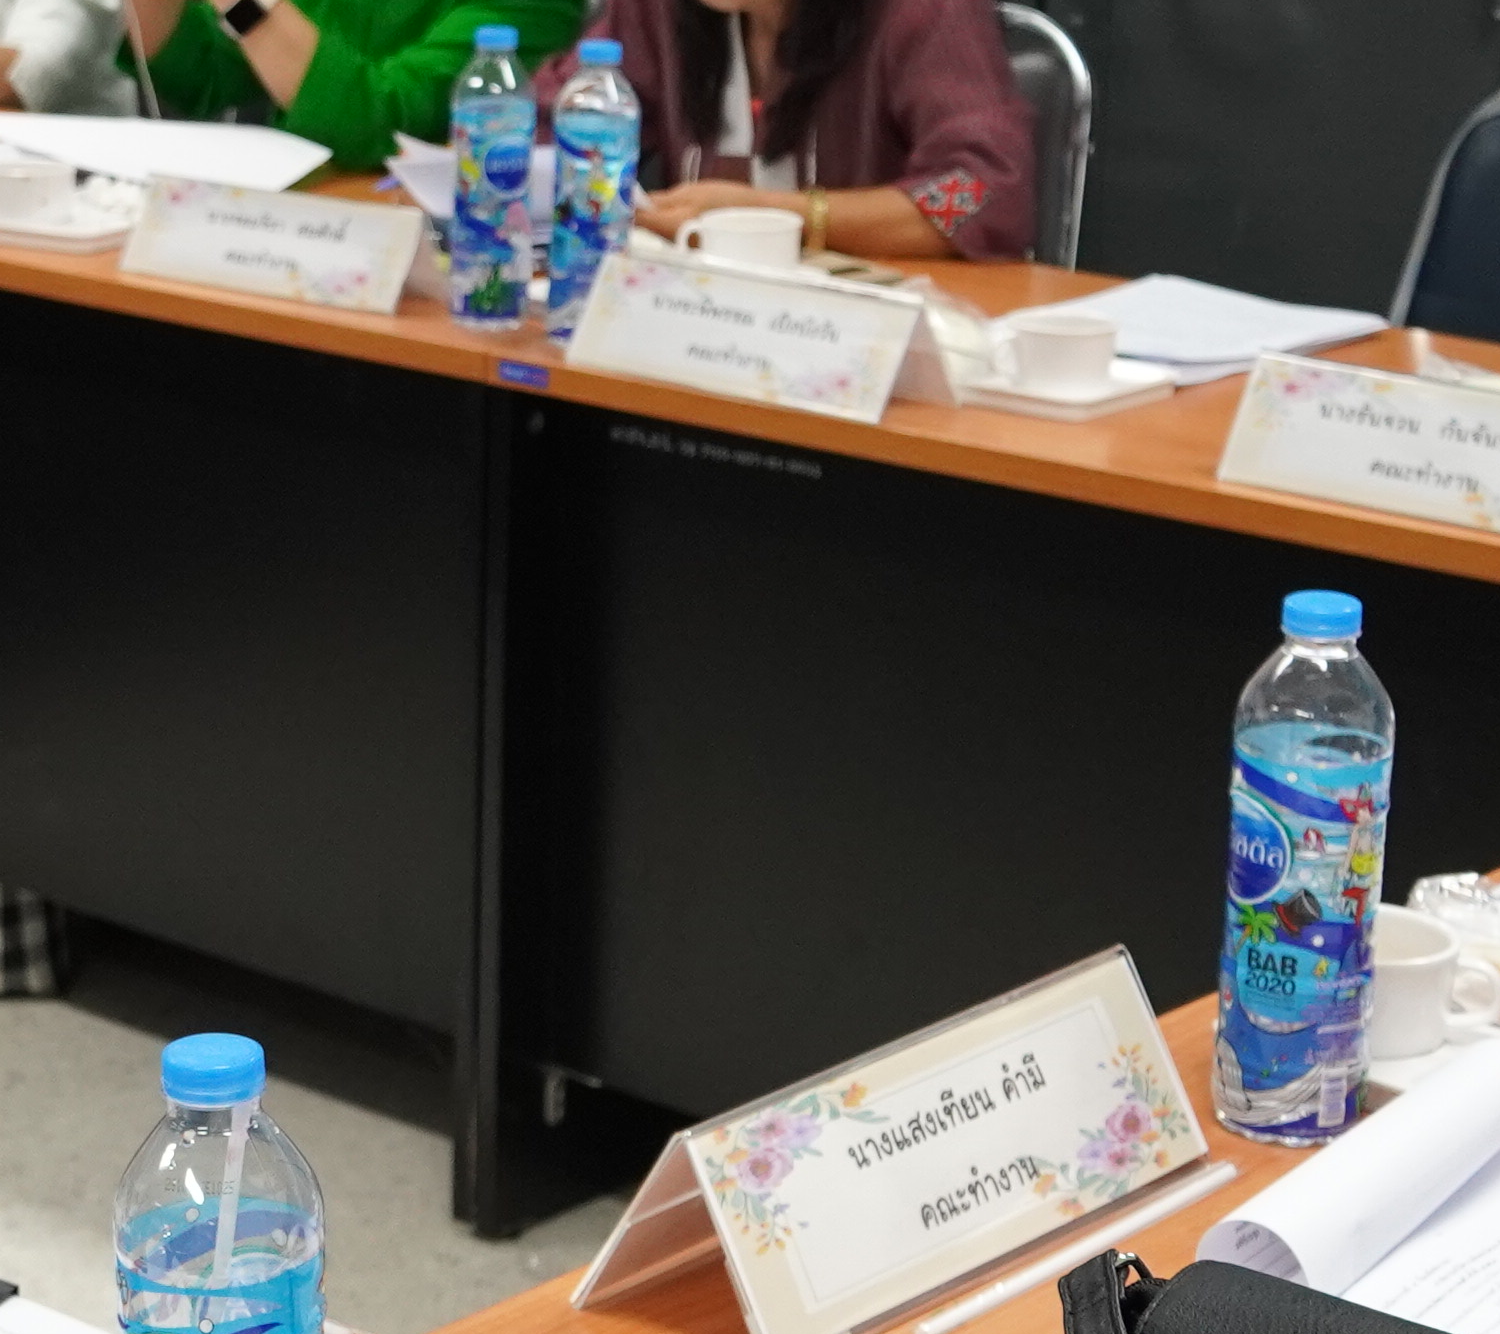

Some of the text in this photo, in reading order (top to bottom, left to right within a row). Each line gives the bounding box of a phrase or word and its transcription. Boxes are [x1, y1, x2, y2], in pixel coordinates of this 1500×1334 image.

[1245, 970, 1296, 997] 2020
[1247, 948, 1298, 977] BAB
[847, 1052, 1048, 1170] นางแสงเทียน คำมี
[920, 1154, 1040, 1231] คณะทำงาน
